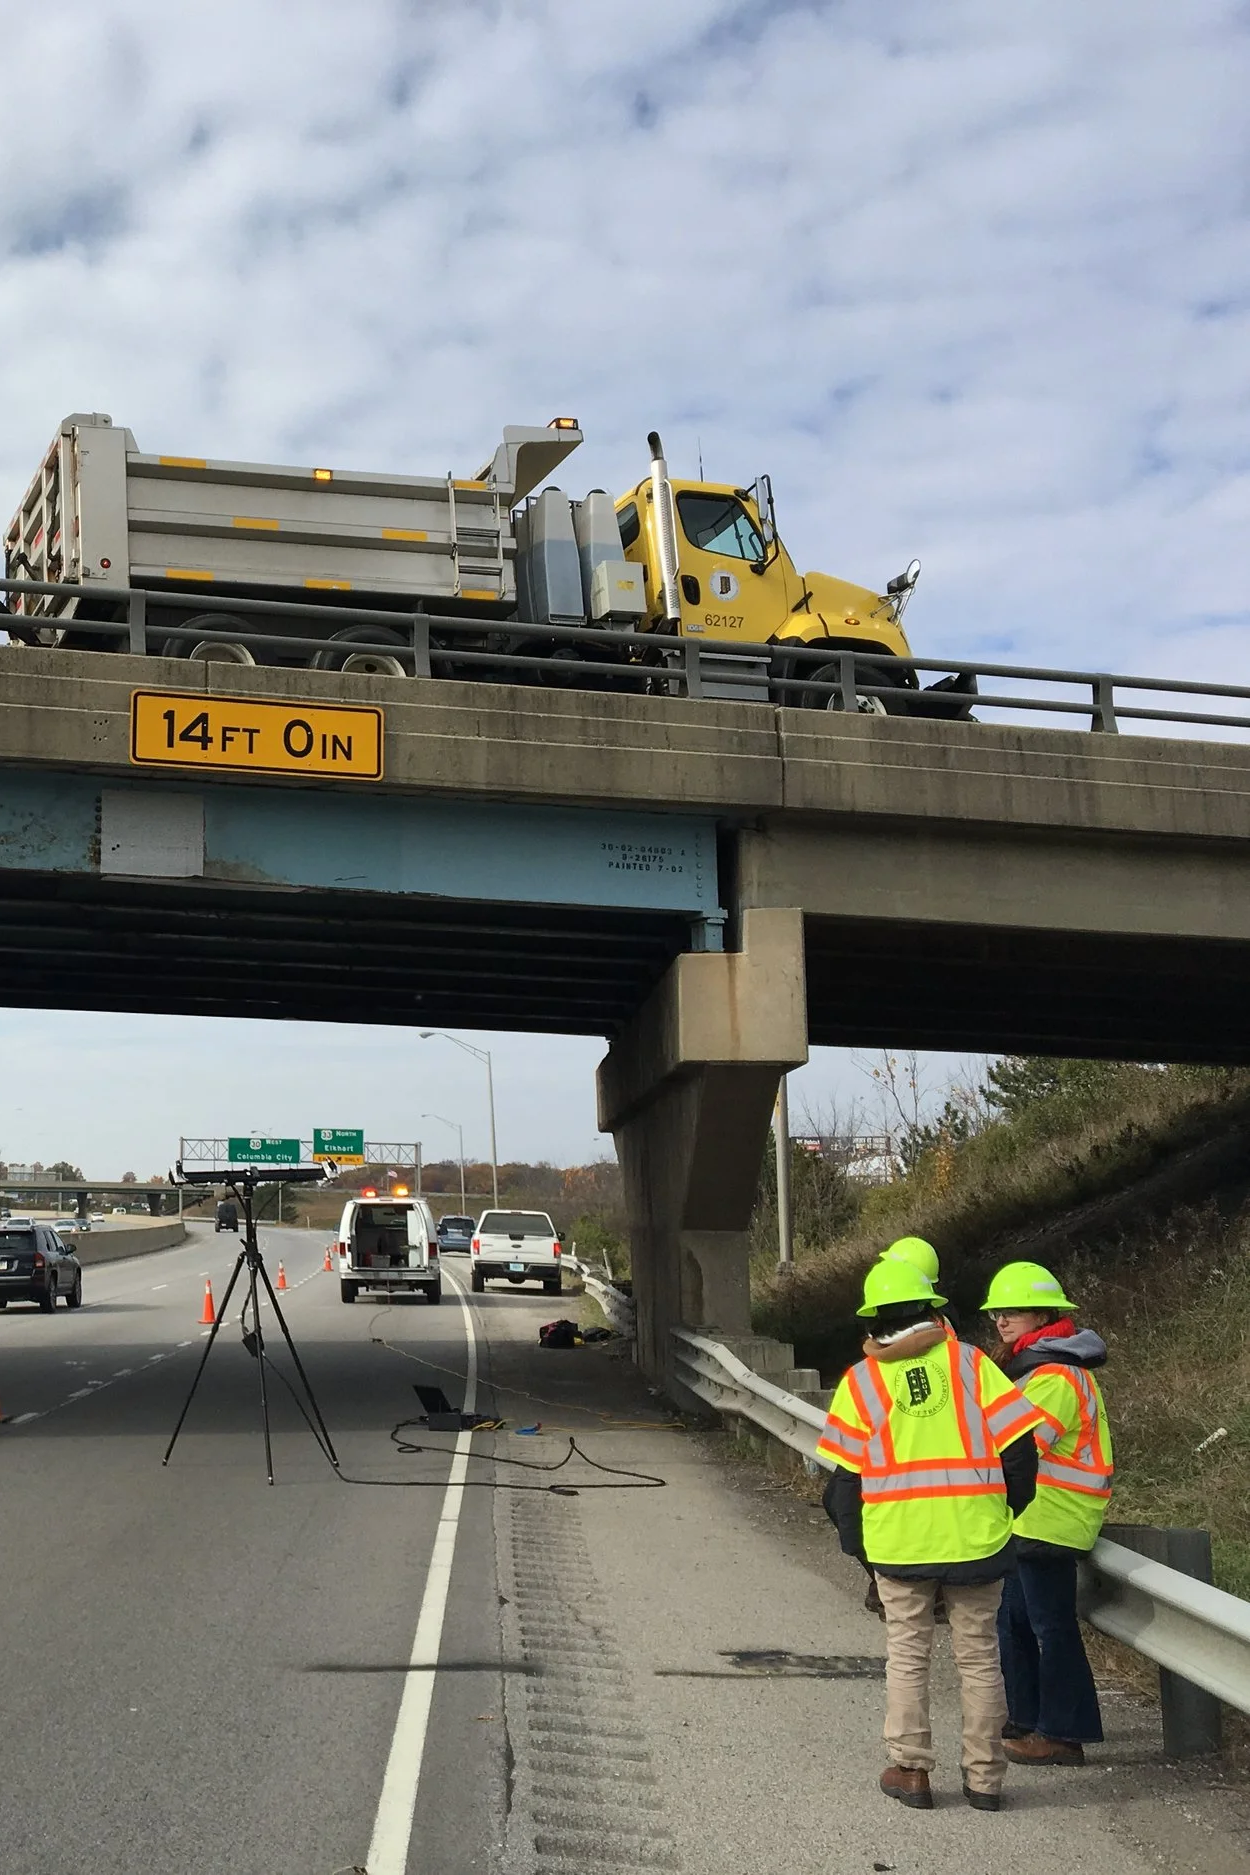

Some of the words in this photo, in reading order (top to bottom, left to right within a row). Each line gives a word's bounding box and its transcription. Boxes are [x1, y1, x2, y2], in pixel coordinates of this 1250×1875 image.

[705, 614, 744, 628] 62127
[608, 862, 651, 871] PAINTED
[658, 865, 684, 873] 7-02
[322, 1131, 332, 1139] 33
[251, 1140, 261, 1148] 30
[324, 1144, 354, 1152] Elkhart
[236, 1153, 272, 1161] Columbia
[276, 1153, 293, 1162] City
[918, 1367, 929, 1395] INDOT
